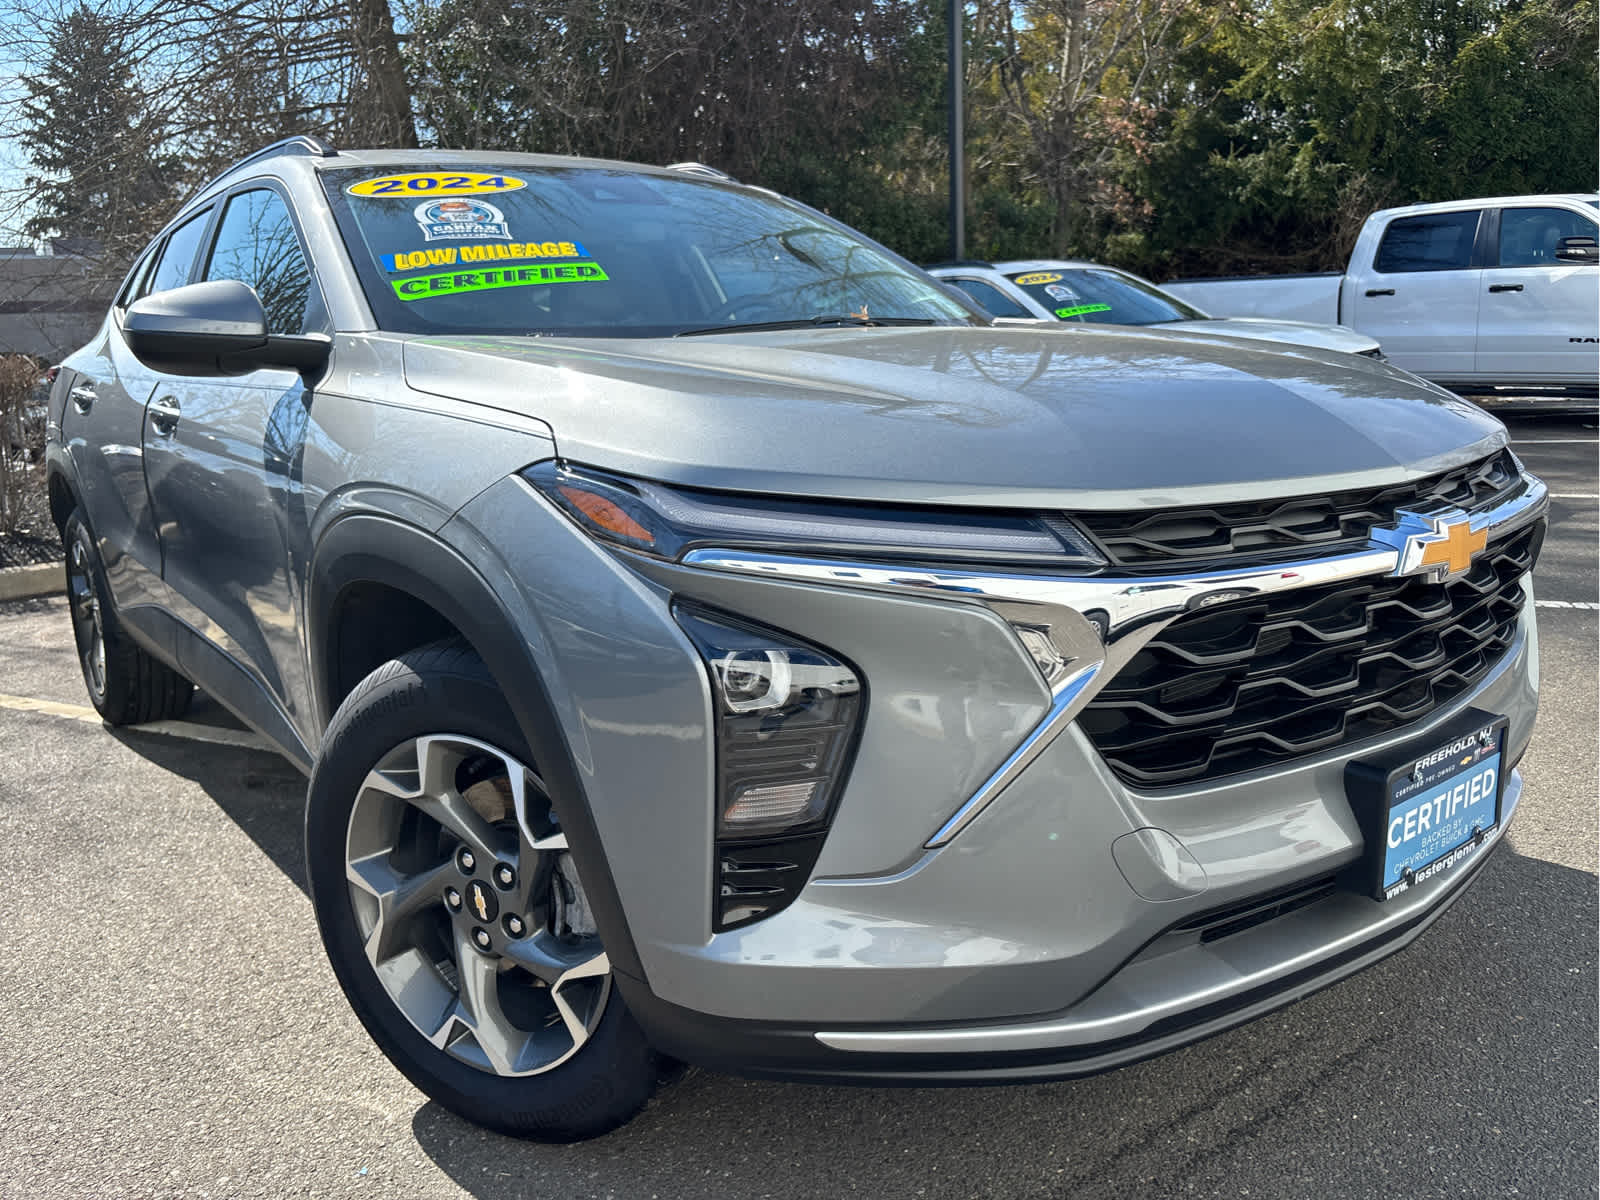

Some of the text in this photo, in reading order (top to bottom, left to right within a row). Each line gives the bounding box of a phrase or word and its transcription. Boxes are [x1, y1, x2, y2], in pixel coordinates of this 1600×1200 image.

[372, 176, 509, 194] 2024
[394, 241, 580, 270] LOW MILEAGE
[399, 266, 601, 295] CERTIFIED
[1414, 735, 1477, 774] FREEHOLD,
[1479, 727, 1493, 741] NJ
[1395, 779, 1424, 799] CERTIFIED
[1387, 768, 1495, 848] CERTIFIED
[1421, 817, 1464, 848] BACKED BY
[1394, 842, 1439, 874] CHEVROLET
[1441, 829, 1463, 847] BUICK
